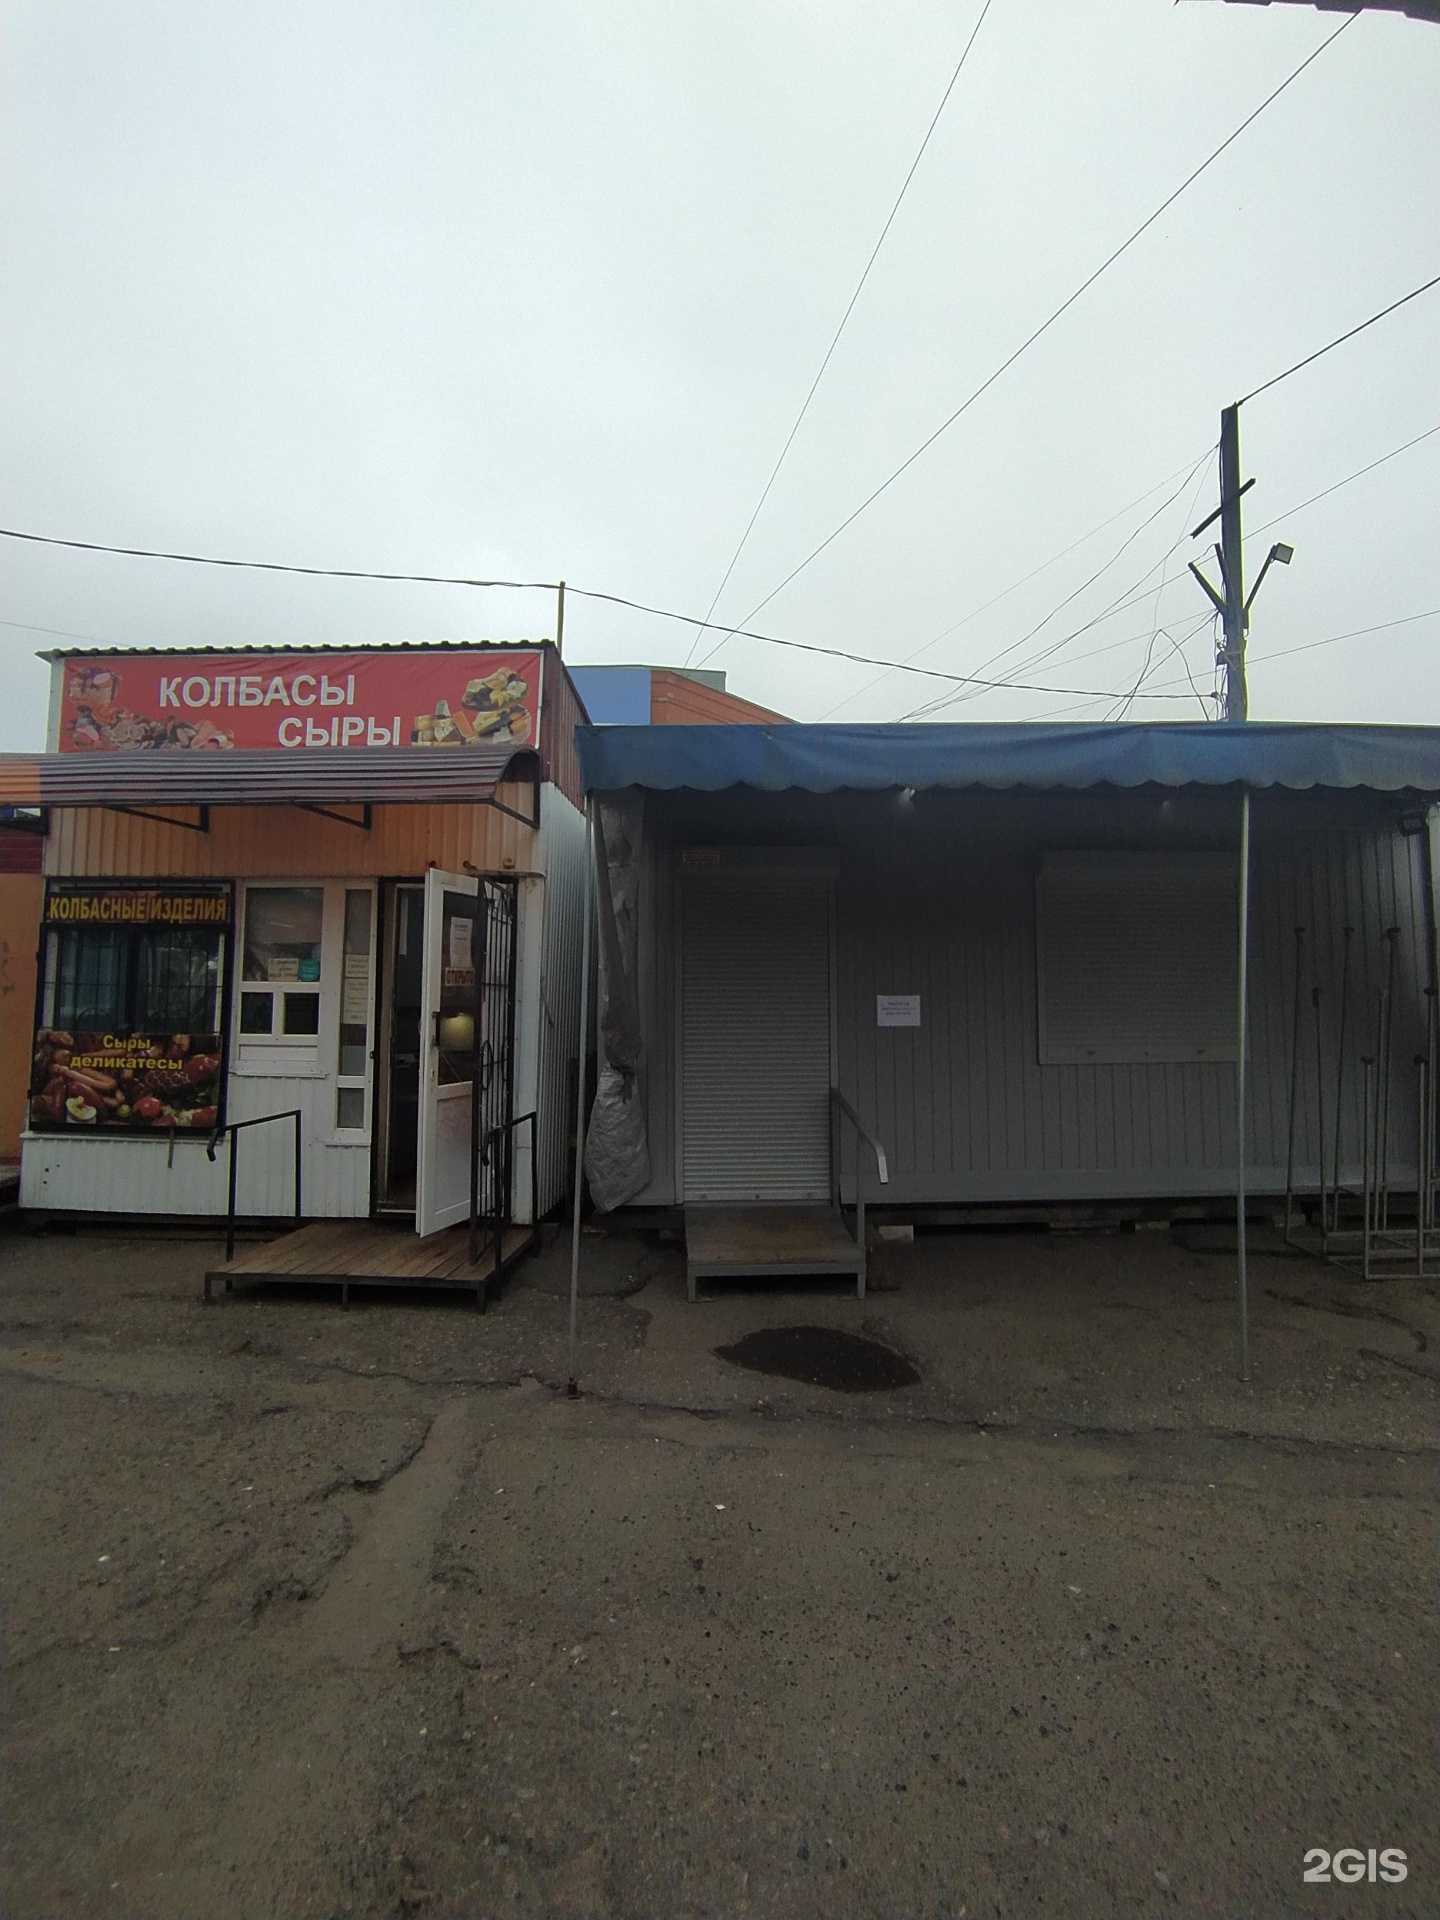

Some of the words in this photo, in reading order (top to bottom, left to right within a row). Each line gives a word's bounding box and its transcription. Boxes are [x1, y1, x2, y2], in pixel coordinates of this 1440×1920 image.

[159, 674, 356, 708] КОЛБАСЫ
[278, 716, 401, 747] СЫРЫ
[49, 896, 145, 920] КОЛБАСНЫЕ
[151, 898, 226, 924] ИЗДЕЛИЯ
[103, 1034, 151, 1052] Сыры
[70, 1056, 183, 1070] деликатесы
